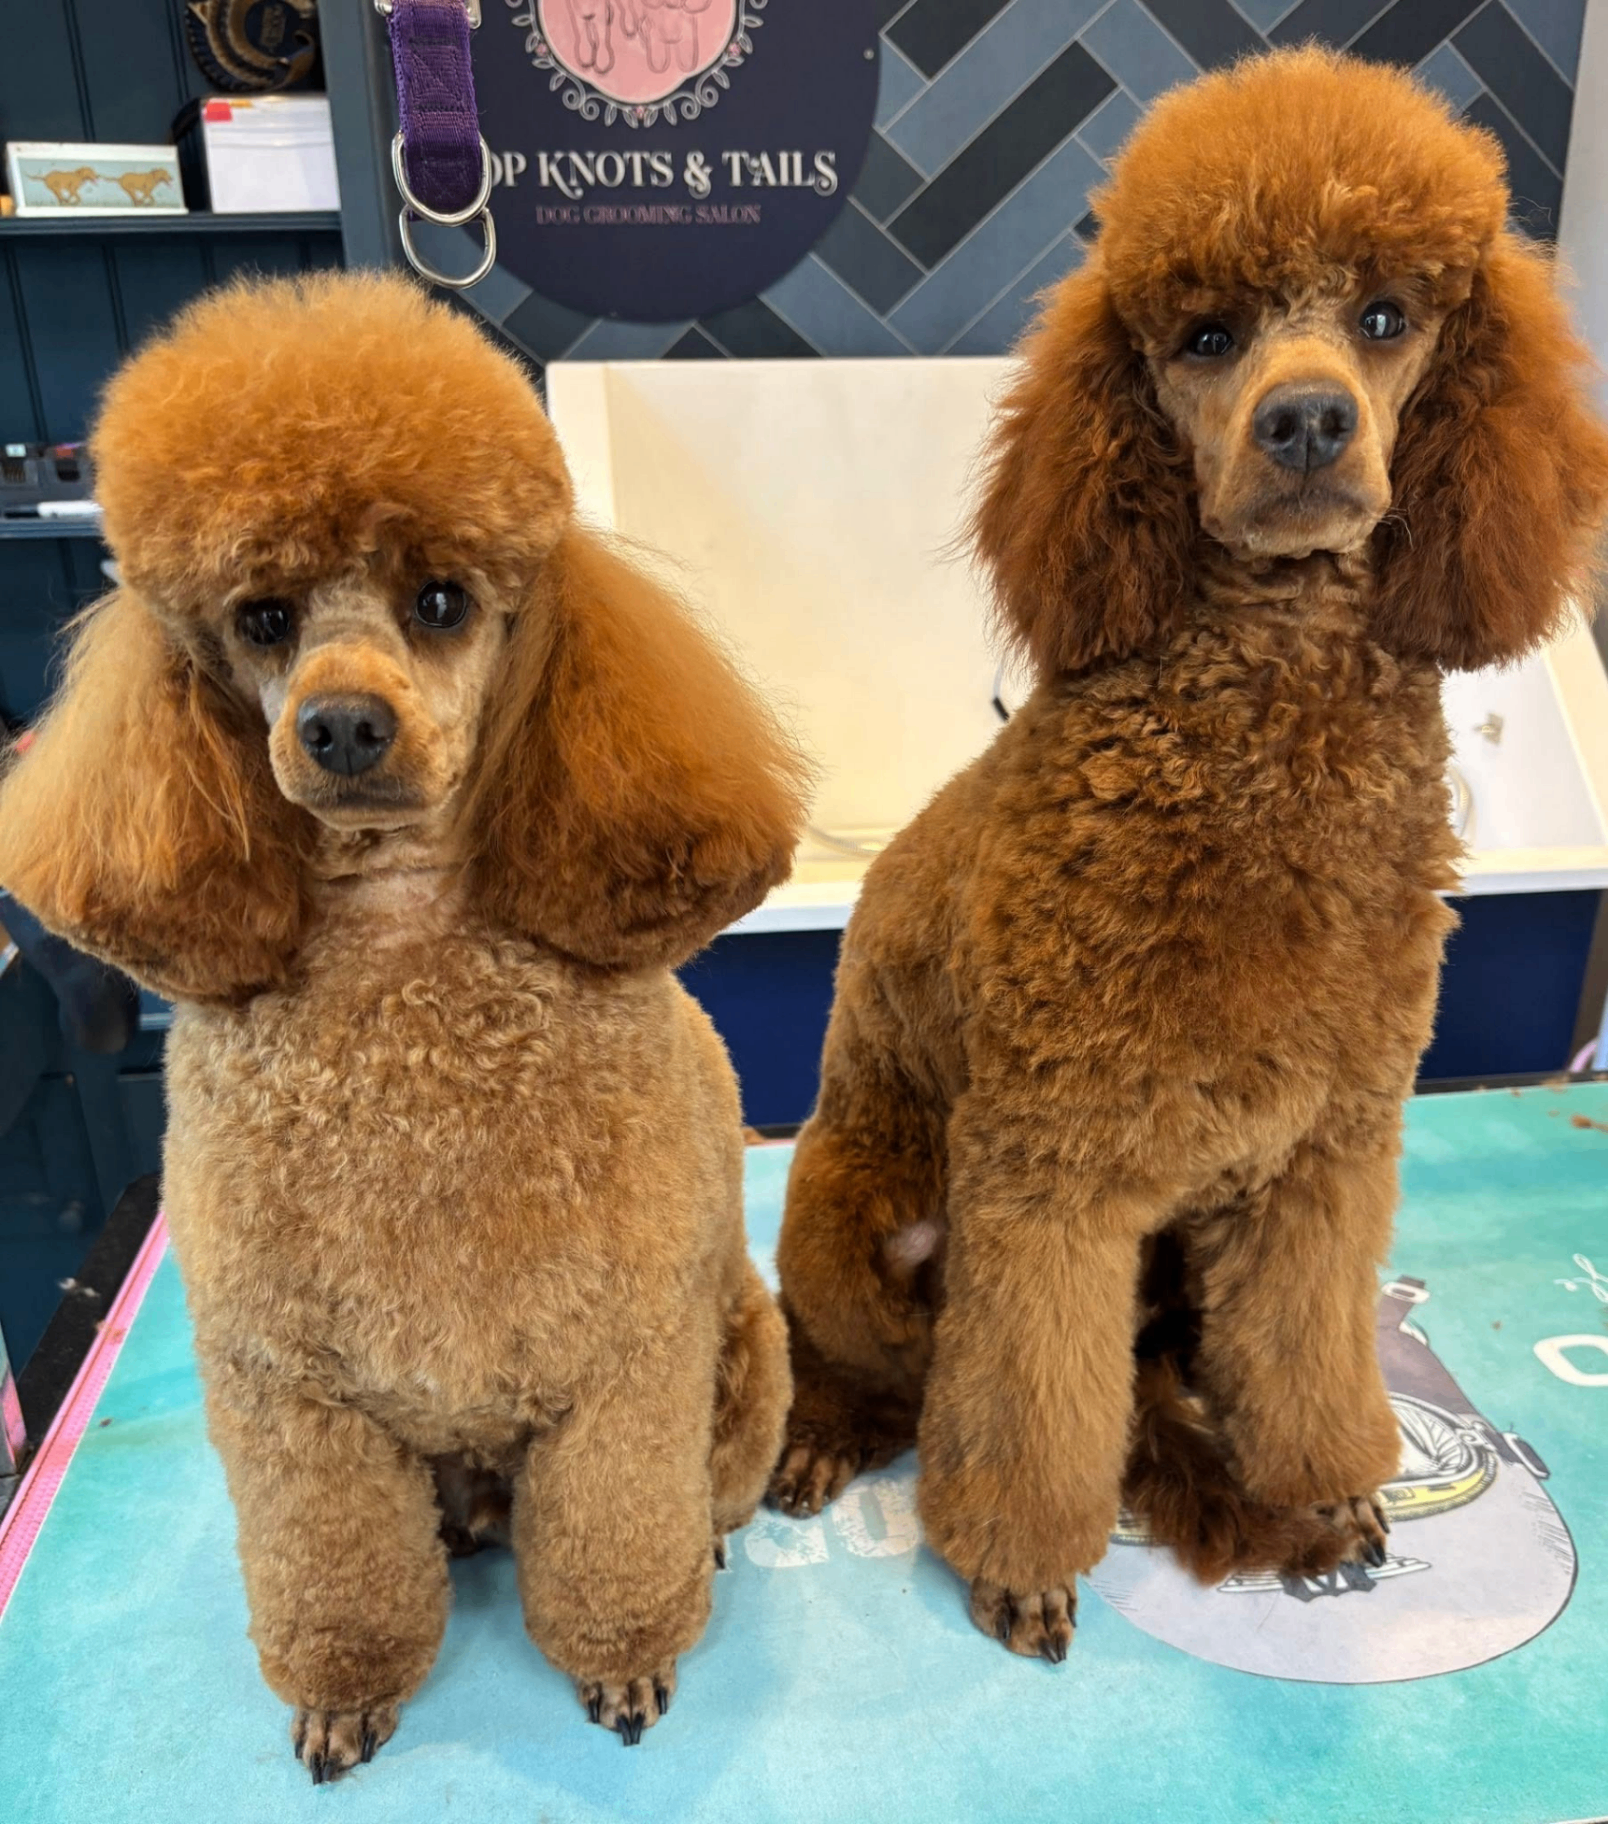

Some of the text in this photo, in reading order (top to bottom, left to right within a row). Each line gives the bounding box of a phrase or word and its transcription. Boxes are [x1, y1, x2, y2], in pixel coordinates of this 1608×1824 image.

[537, 151, 674, 200] KNOTS
[684, 151, 713, 199] &
[722, 151, 838, 197] TAILS
[536, 205, 761, 225] DOG GROOMING SALON
